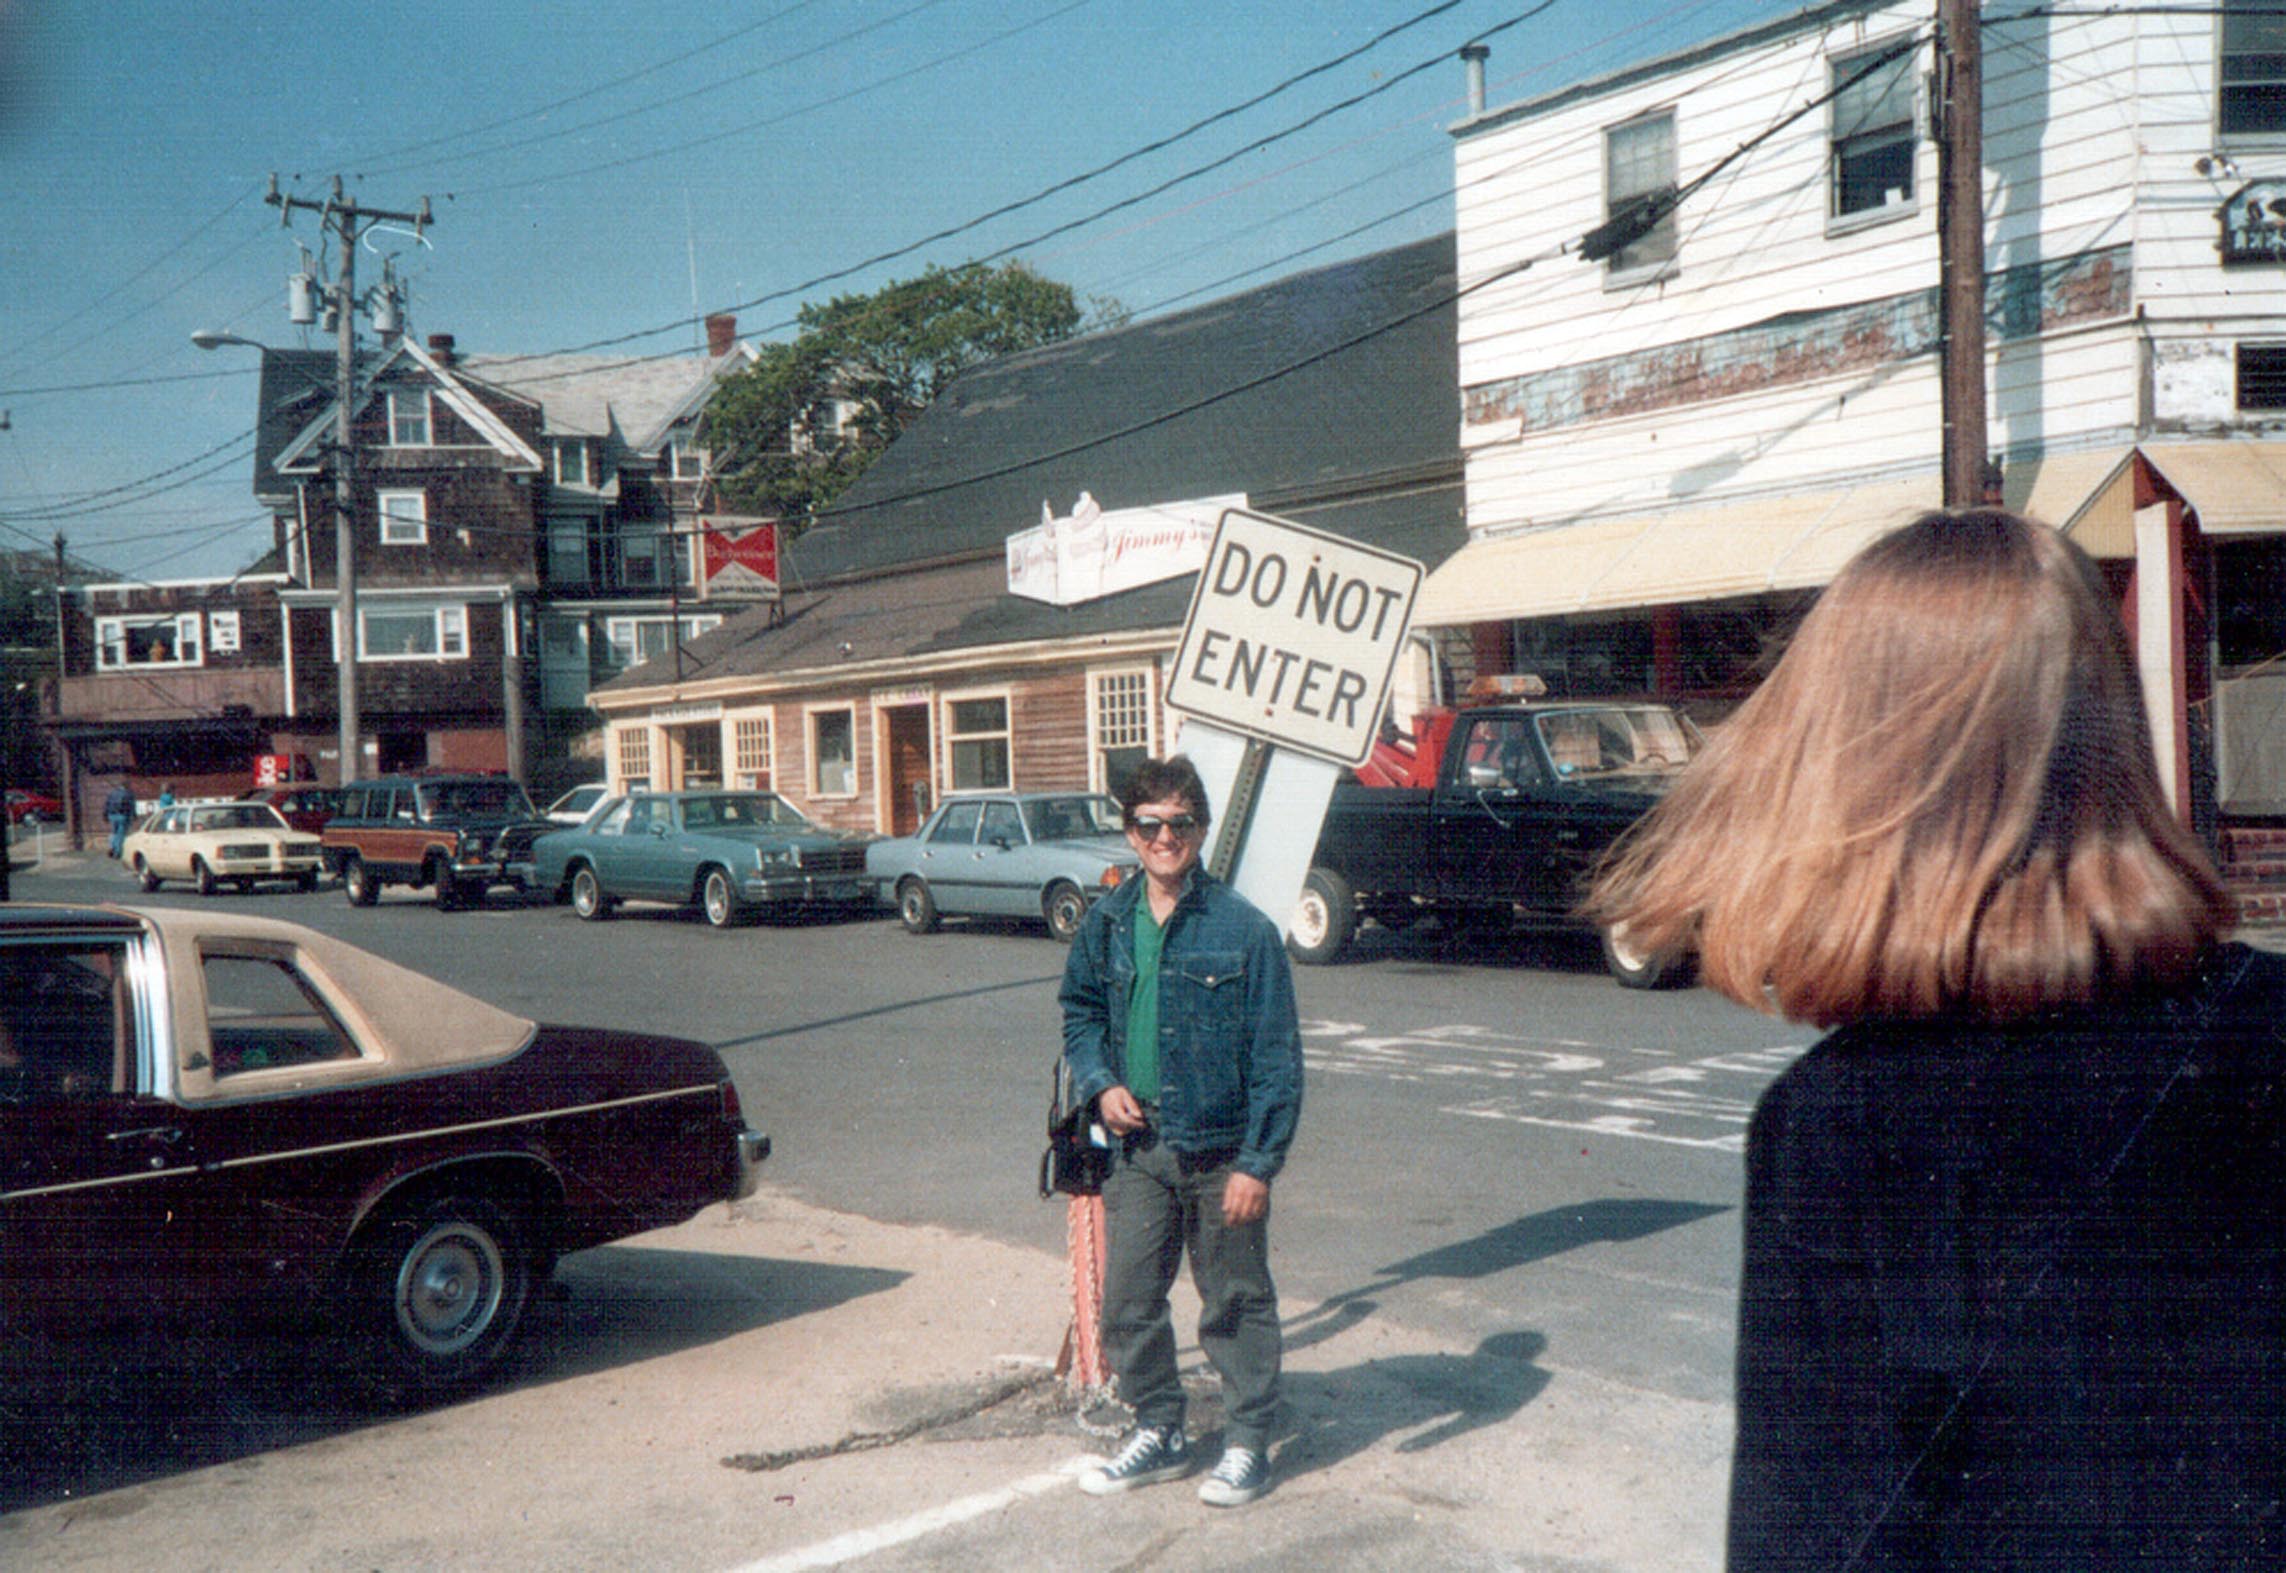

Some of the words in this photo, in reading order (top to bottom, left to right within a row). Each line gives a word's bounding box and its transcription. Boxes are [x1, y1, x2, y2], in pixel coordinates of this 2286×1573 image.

[1212, 541, 1287, 608] DO
[1295, 565, 1403, 641] NOT
[1191, 628, 1367, 728] ENTER
